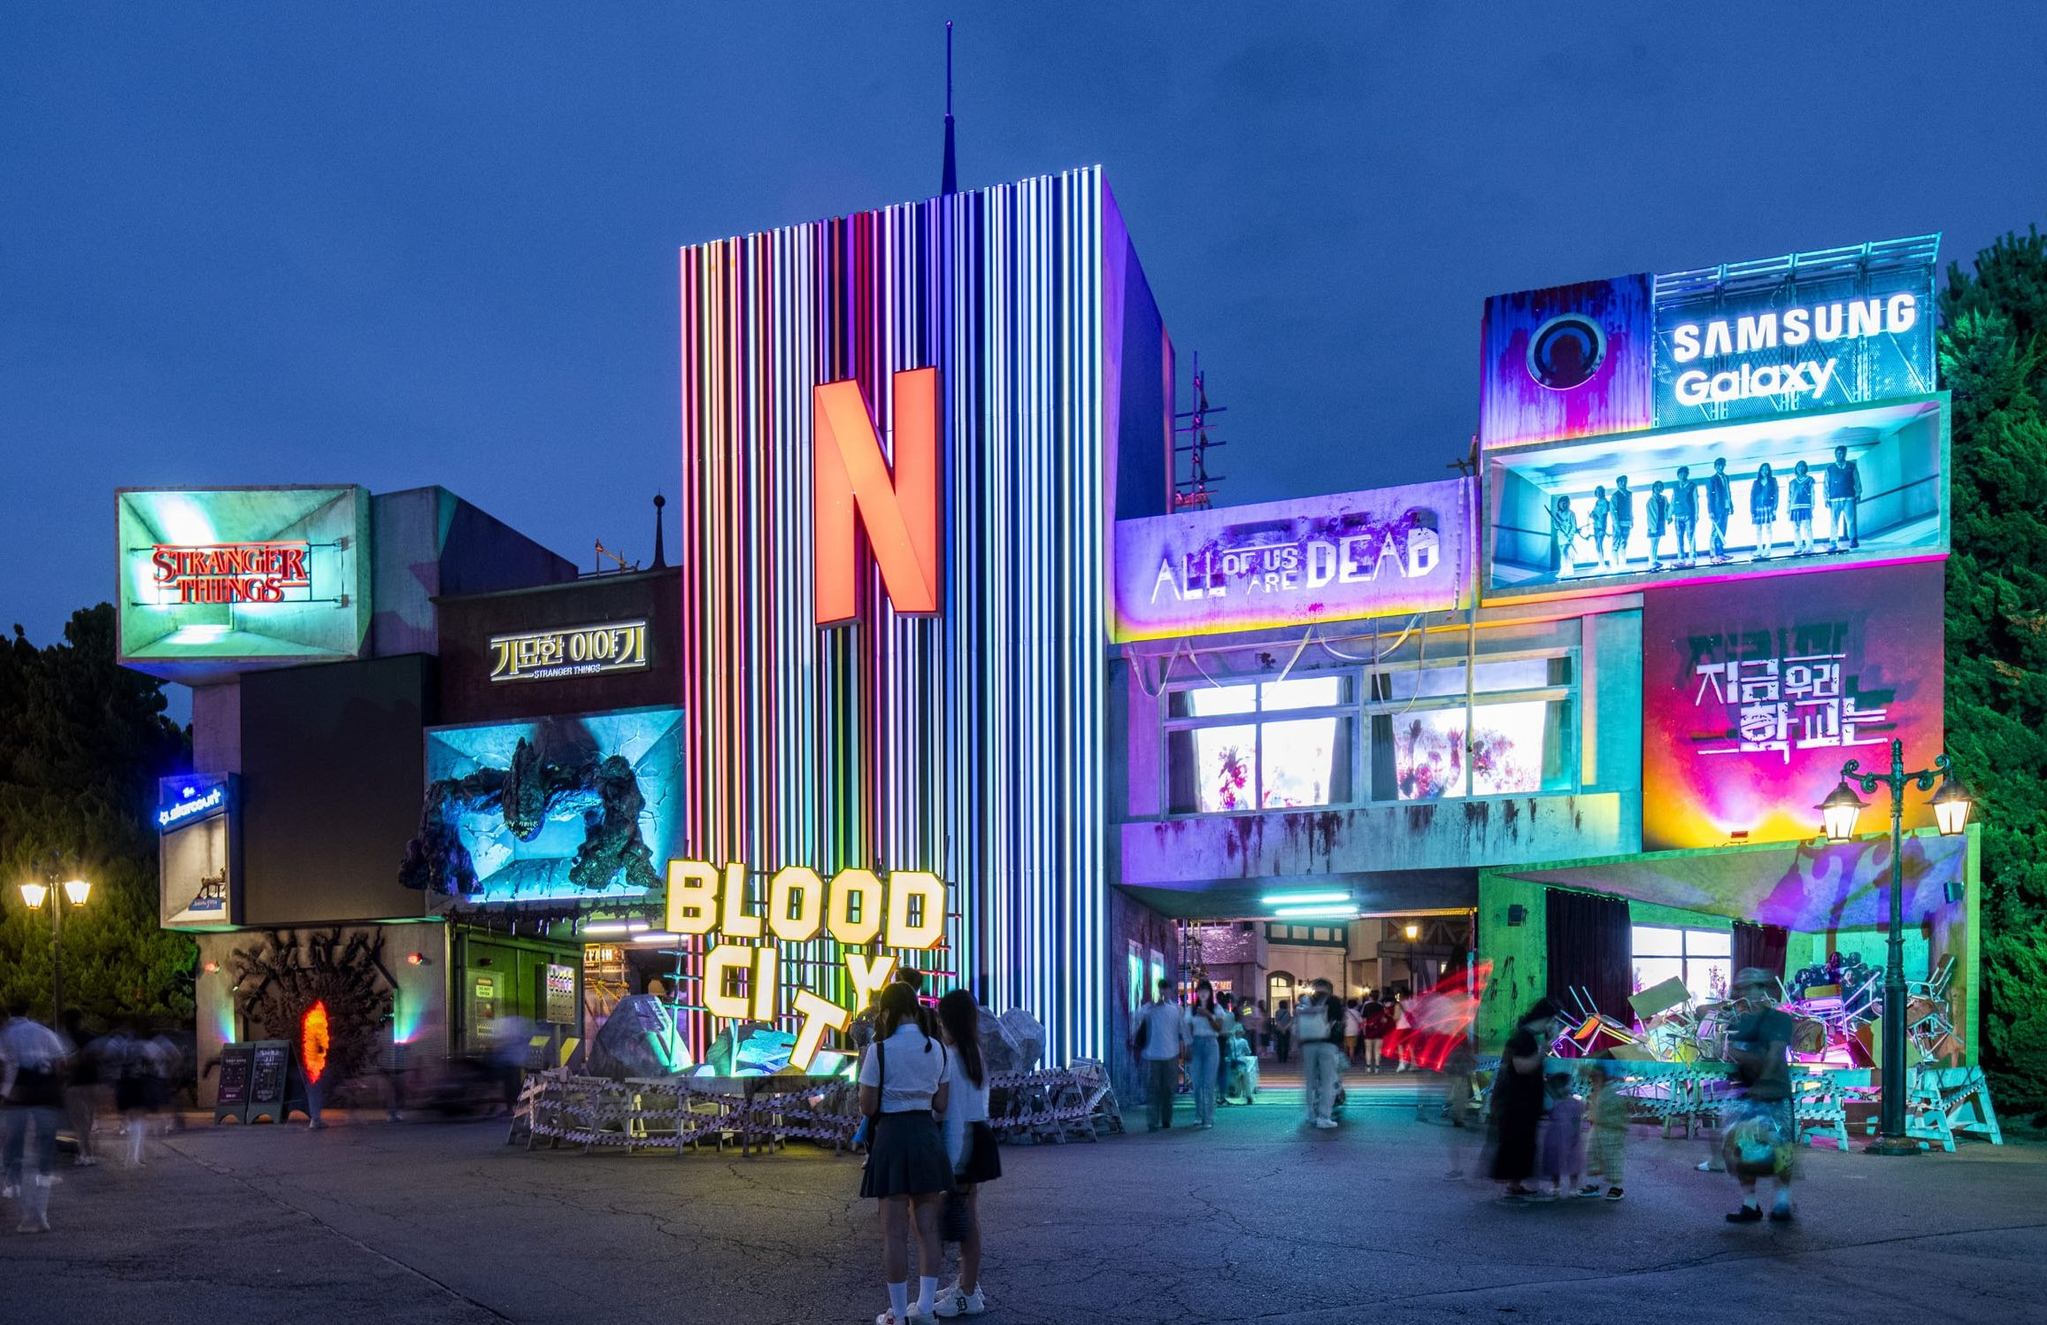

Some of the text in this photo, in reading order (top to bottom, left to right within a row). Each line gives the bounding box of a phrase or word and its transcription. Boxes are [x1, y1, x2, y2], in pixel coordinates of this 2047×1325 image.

[1673, 294, 1916, 362] SAMSUNG
[1675, 358, 1837, 406] Galaxy
[813, 366, 939, 625] N
[152, 547, 309, 582] STRANGER
[177, 577, 284, 603] THINGS
[1151, 527, 1440, 604] ALL OF US ARE DEAD
[490, 626, 646, 678] 기묘한 이야기
[534, 664, 602, 679] STRANGER THINGS
[1738, 697, 1888, 765] 학교는
[666, 859, 948, 949] BLOOD
[703, 944, 901, 1071] CITY
